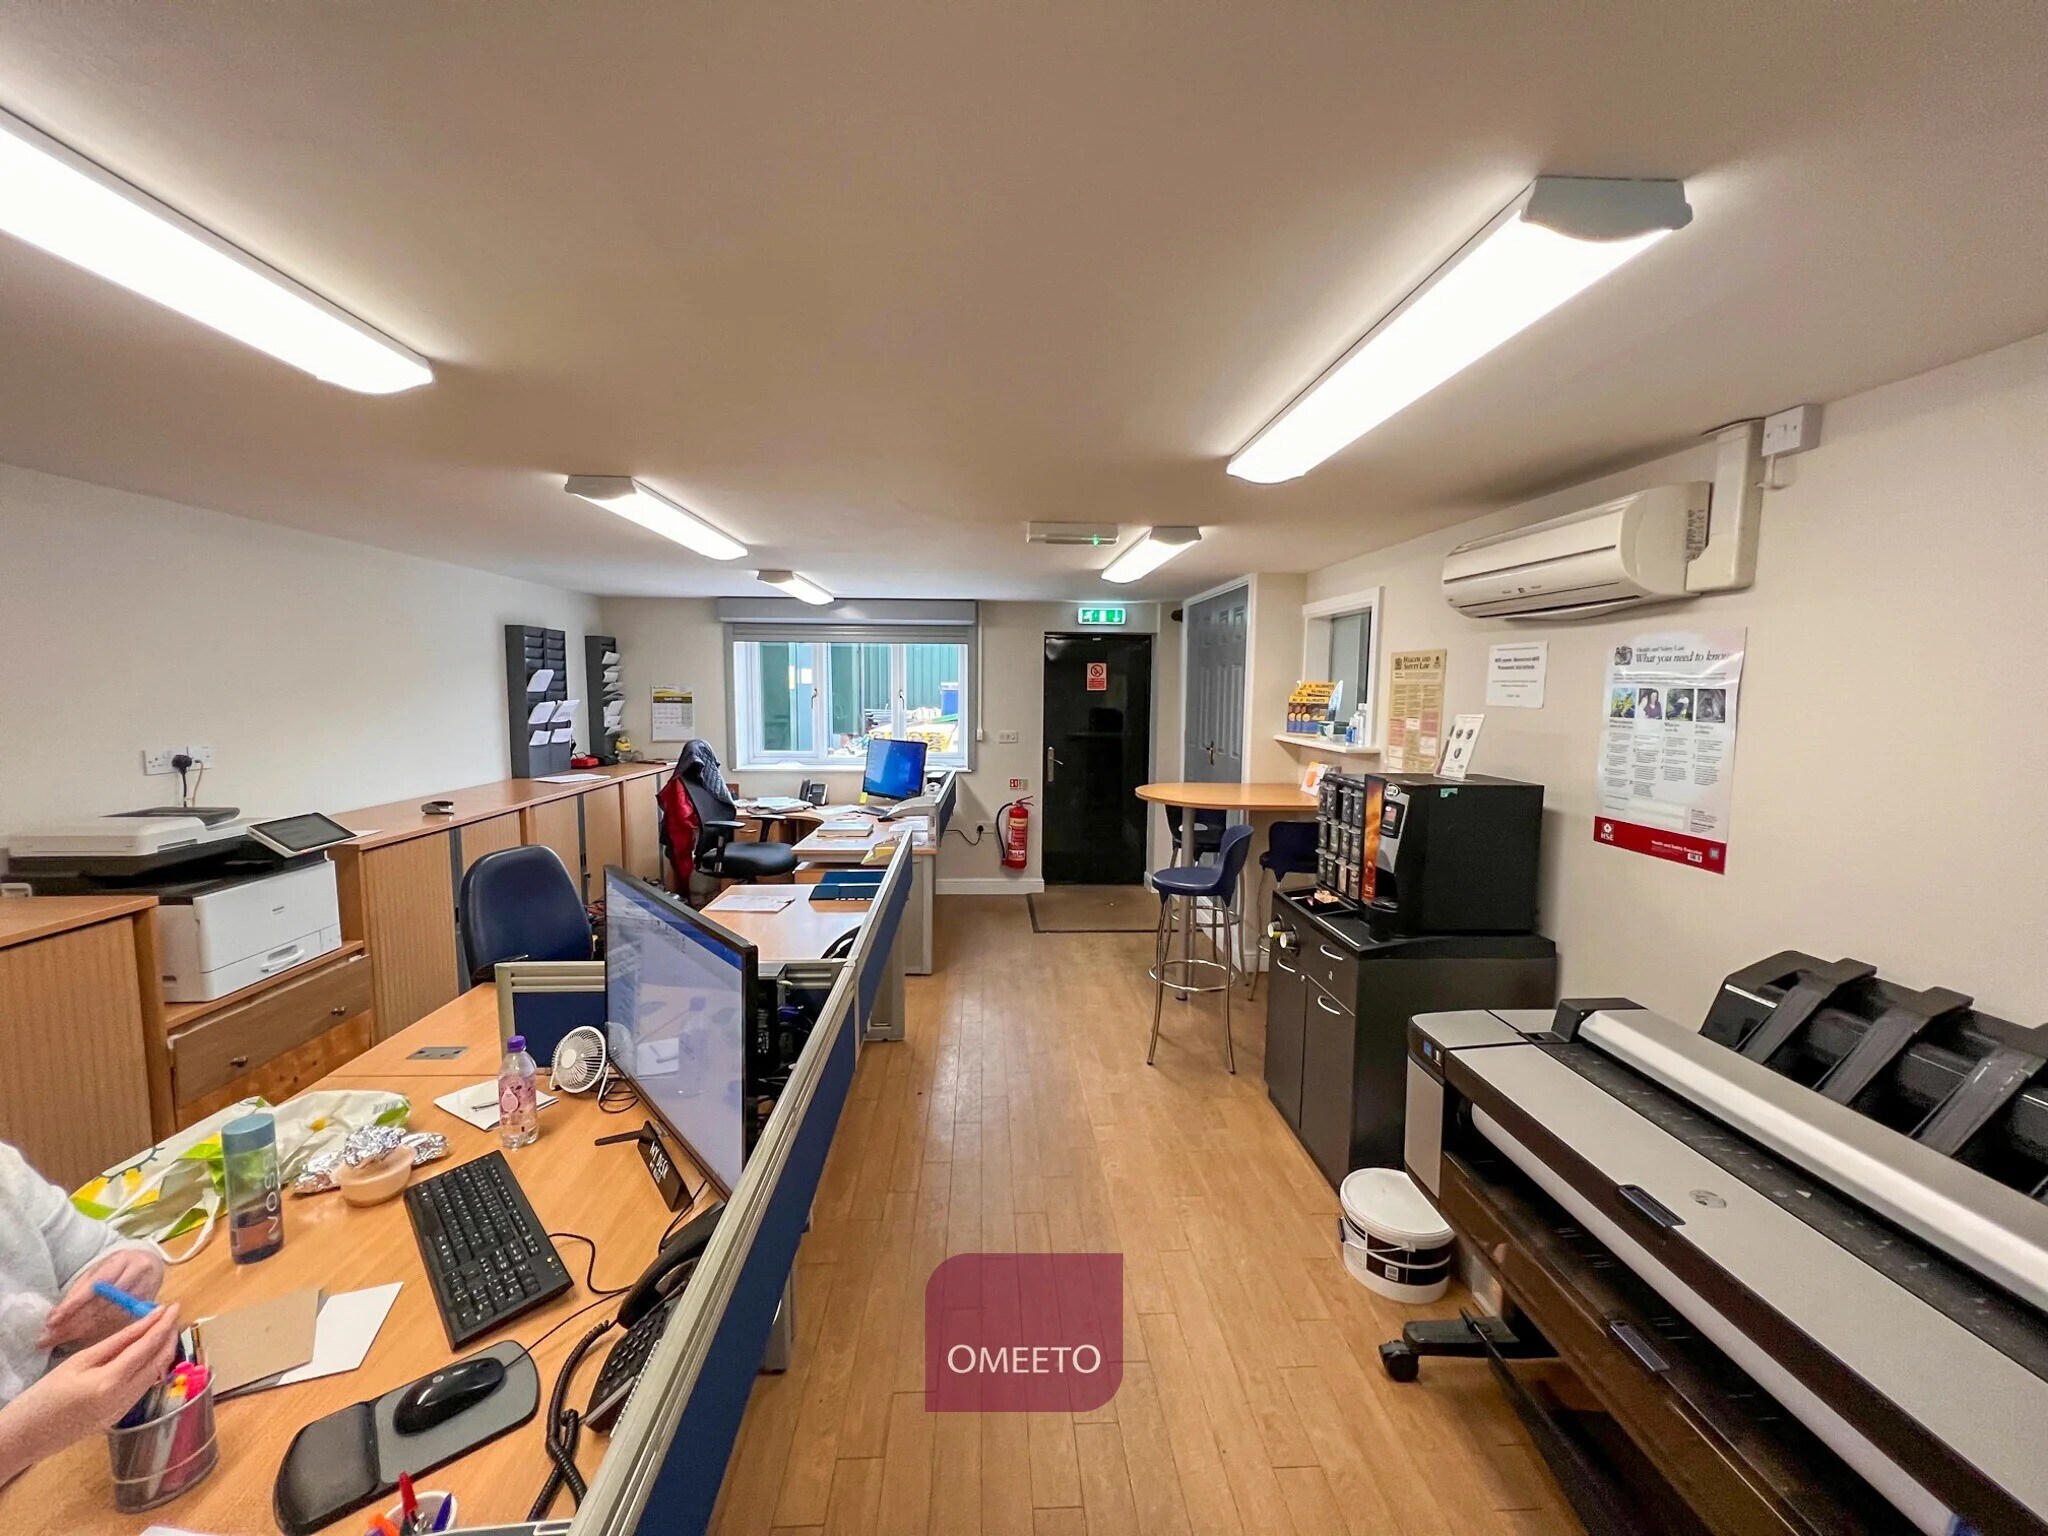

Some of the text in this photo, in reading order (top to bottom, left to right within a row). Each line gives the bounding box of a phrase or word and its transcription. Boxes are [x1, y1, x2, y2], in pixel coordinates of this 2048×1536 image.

[1636, 653, 1655, 663] What
[1656, 655, 1672, 665] you
[1673, 651, 1694, 662] need
[1696, 652, 1704, 661] to
[1600, 832, 1614, 841] HSE
[263, 1152, 279, 1234] VOSS
